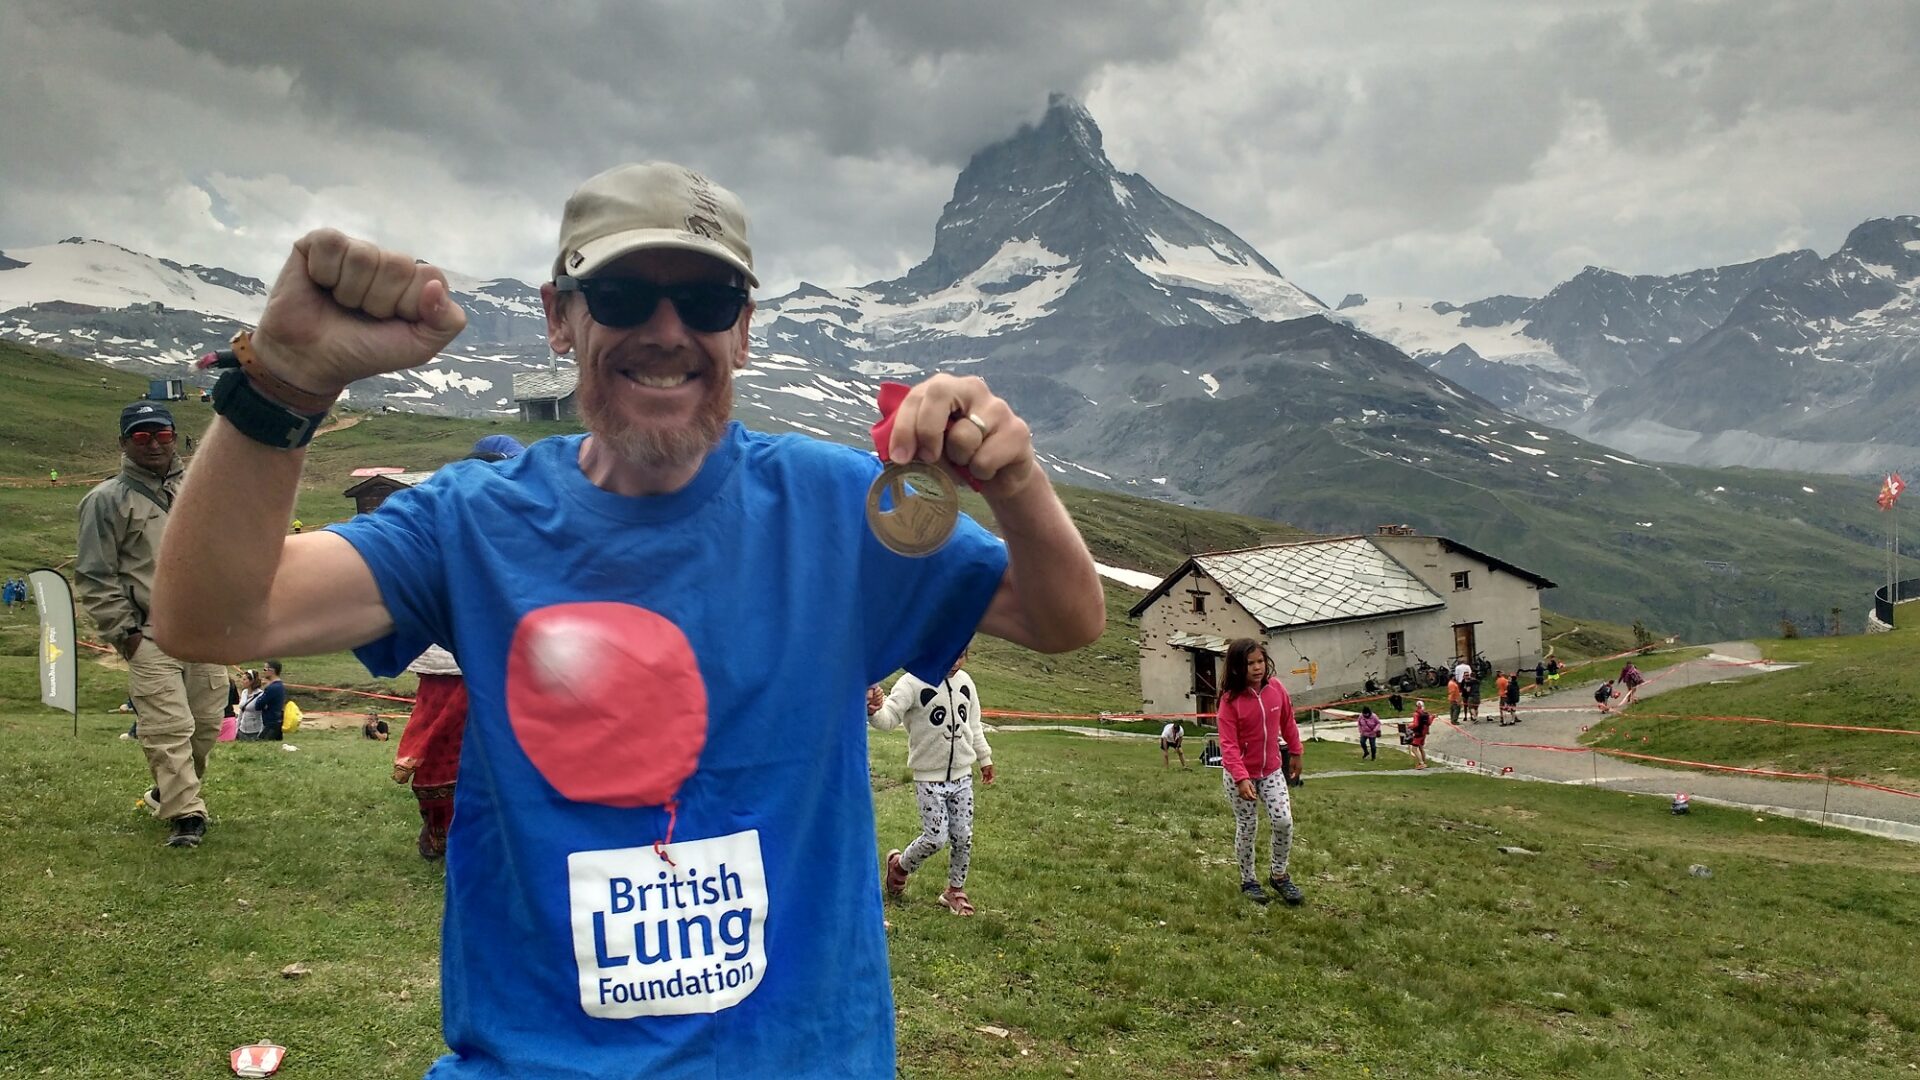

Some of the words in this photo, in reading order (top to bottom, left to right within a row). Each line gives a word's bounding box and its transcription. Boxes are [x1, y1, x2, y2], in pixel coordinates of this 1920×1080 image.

[610, 863, 743, 914] British
[592, 907, 752, 968] Lung
[599, 962, 754, 1005] Foundation
